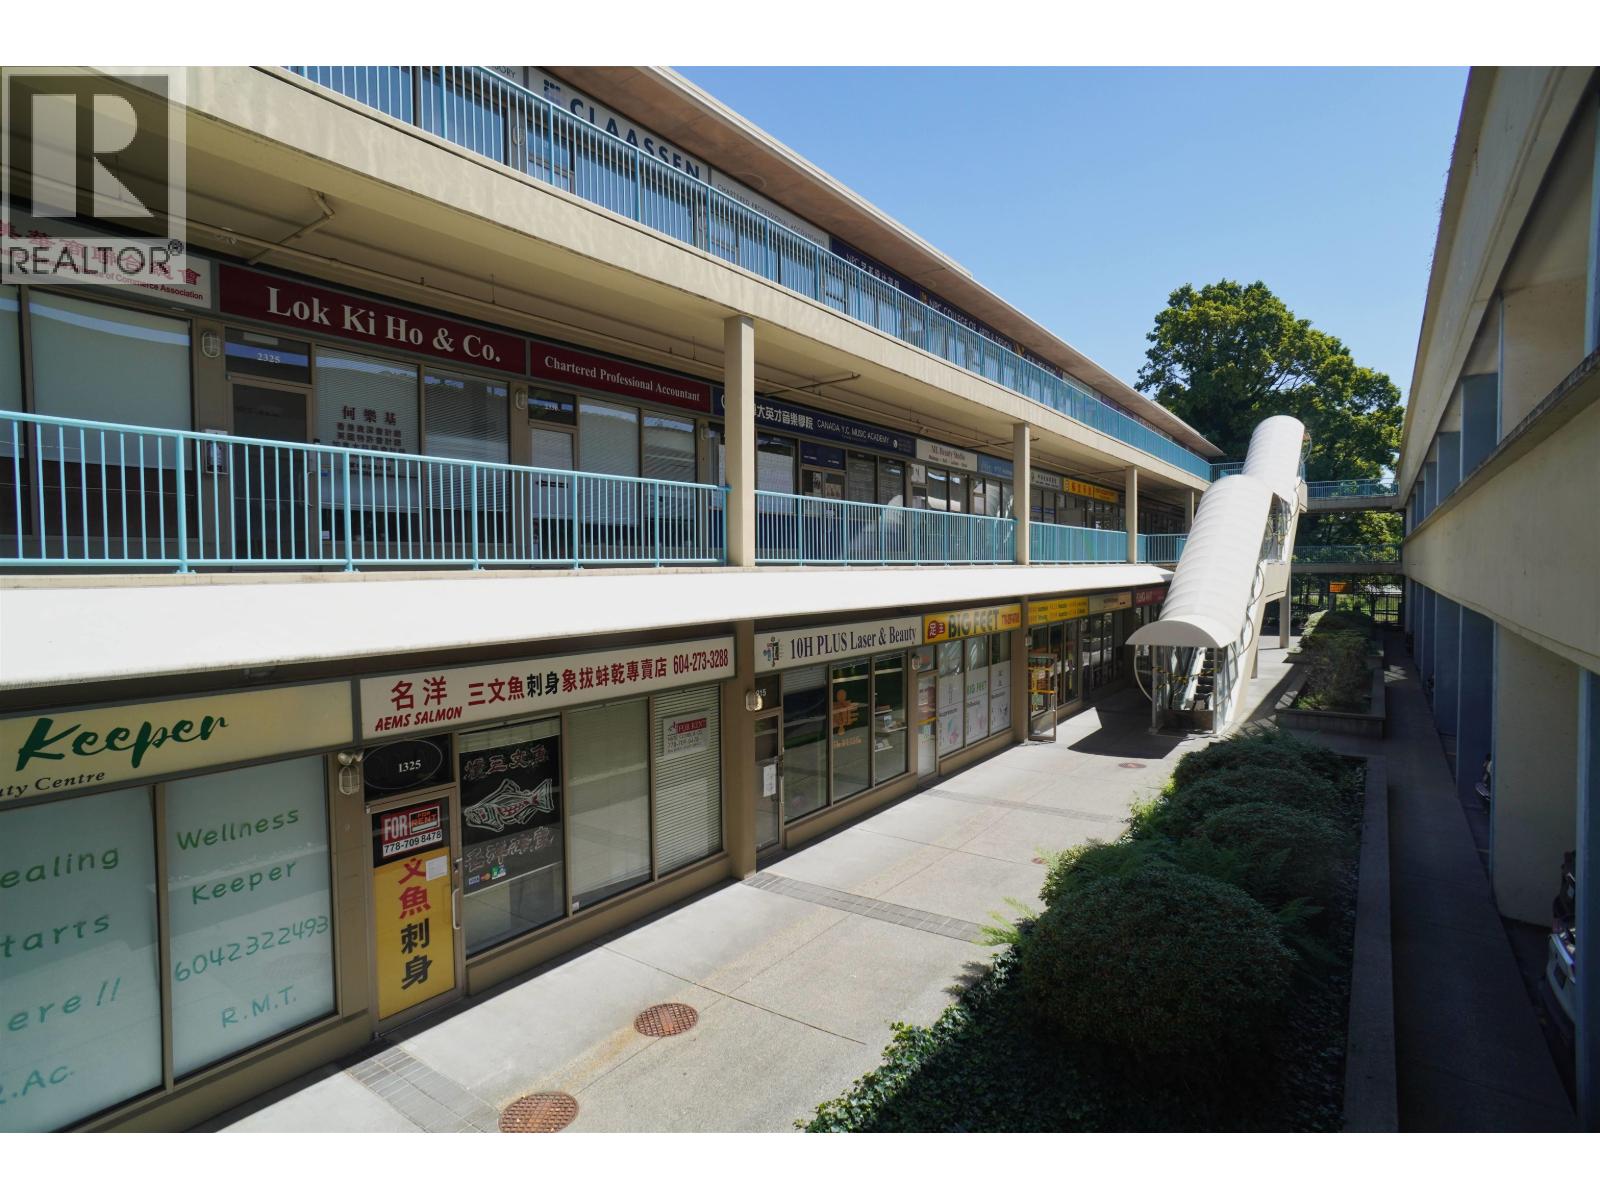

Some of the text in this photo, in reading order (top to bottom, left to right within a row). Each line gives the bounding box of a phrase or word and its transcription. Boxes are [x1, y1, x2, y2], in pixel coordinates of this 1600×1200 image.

[160, 284, 203, 300] Association
[266, 285, 501, 363] Lok Ki Ho & Co.
[256, 352, 281, 364] 2325
[544, 355, 701, 401] Chartered Professional Accountant
[817, 418, 840, 433] CANADA
[851, 428, 867, 439] MUSIC
[867, 432, 890, 445] ACADEMY
[948, 612, 971, 641] BIG
[973, 608, 999, 636] FEET
[790, 638, 814, 660] 10H
[817, 632, 848, 657] PLUS
[850, 630, 876, 650] Laser
[878, 627, 887, 645] &
[889, 625, 917, 645] Beauty
[673, 648, 729, 676] 604-273-3288
[390, 675, 448, 711] 名洋
[374, 705, 463, 733] AEMS SALMON
[15, 715, 230, 772] Keeper
[34, 769, 106, 791] Centre
[398, 759, 422, 773] 1325
[176, 808, 300, 852] Wellness
[383, 813, 409, 841] FOR
[191, 861, 297, 905] Keeper
[174, 915, 329, 982] 6042322493
[221, 984, 297, 1028] R.M.T.
[0, 1064, 74, 1103] .Ac.
